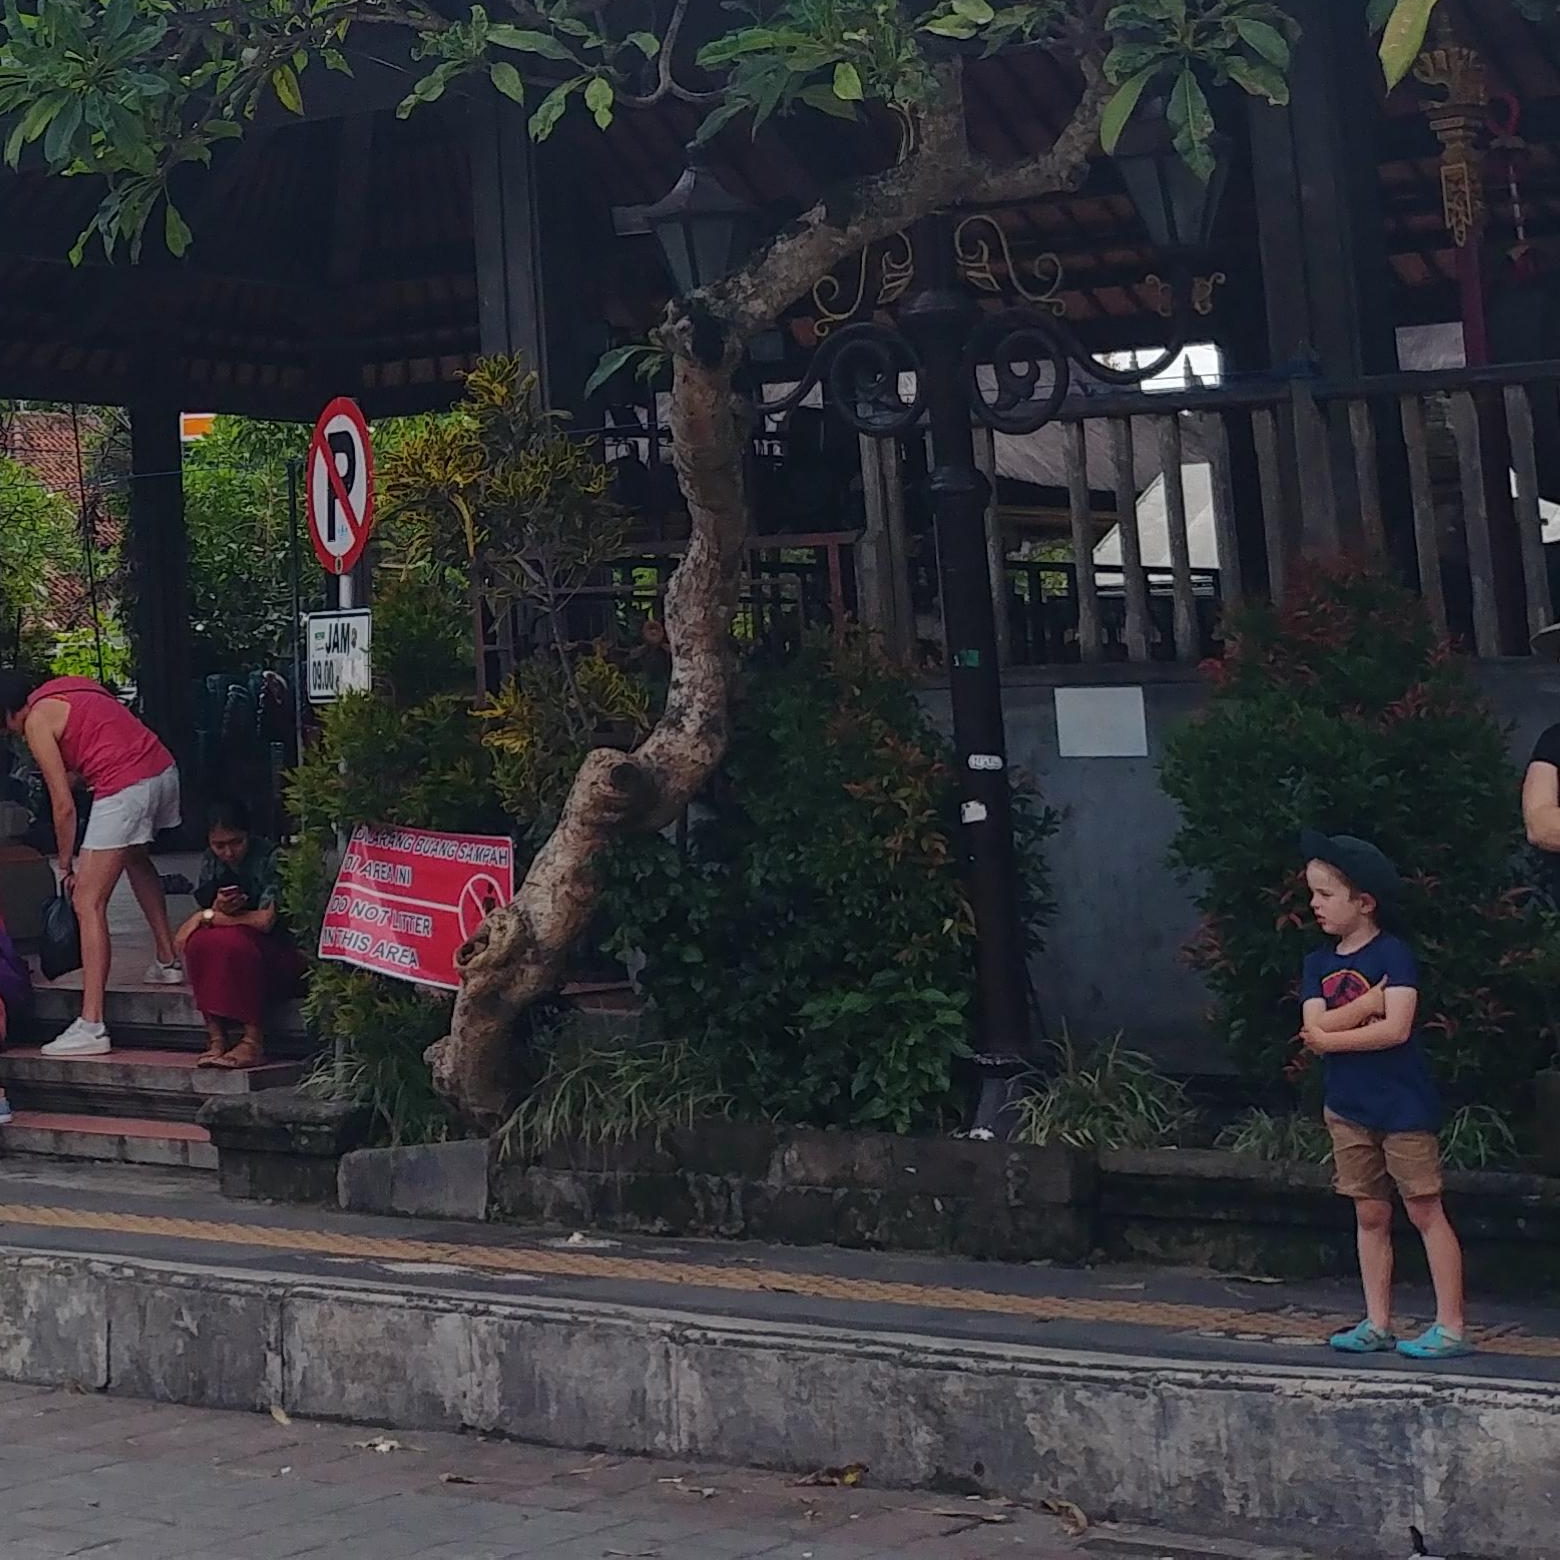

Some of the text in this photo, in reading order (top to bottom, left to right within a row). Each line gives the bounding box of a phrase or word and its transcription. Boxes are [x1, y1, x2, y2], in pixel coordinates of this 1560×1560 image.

[326, 623, 350, 655] JAM
[414, 836, 458, 860] BUANG
[457, 843, 509, 869] SAMPAH
[359, 860, 394, 884] AREA
[395, 865, 412, 887] INI
[330, 896, 433, 937] DO NOT LITTER
[322, 926, 420, 970] IN THIS AREA
